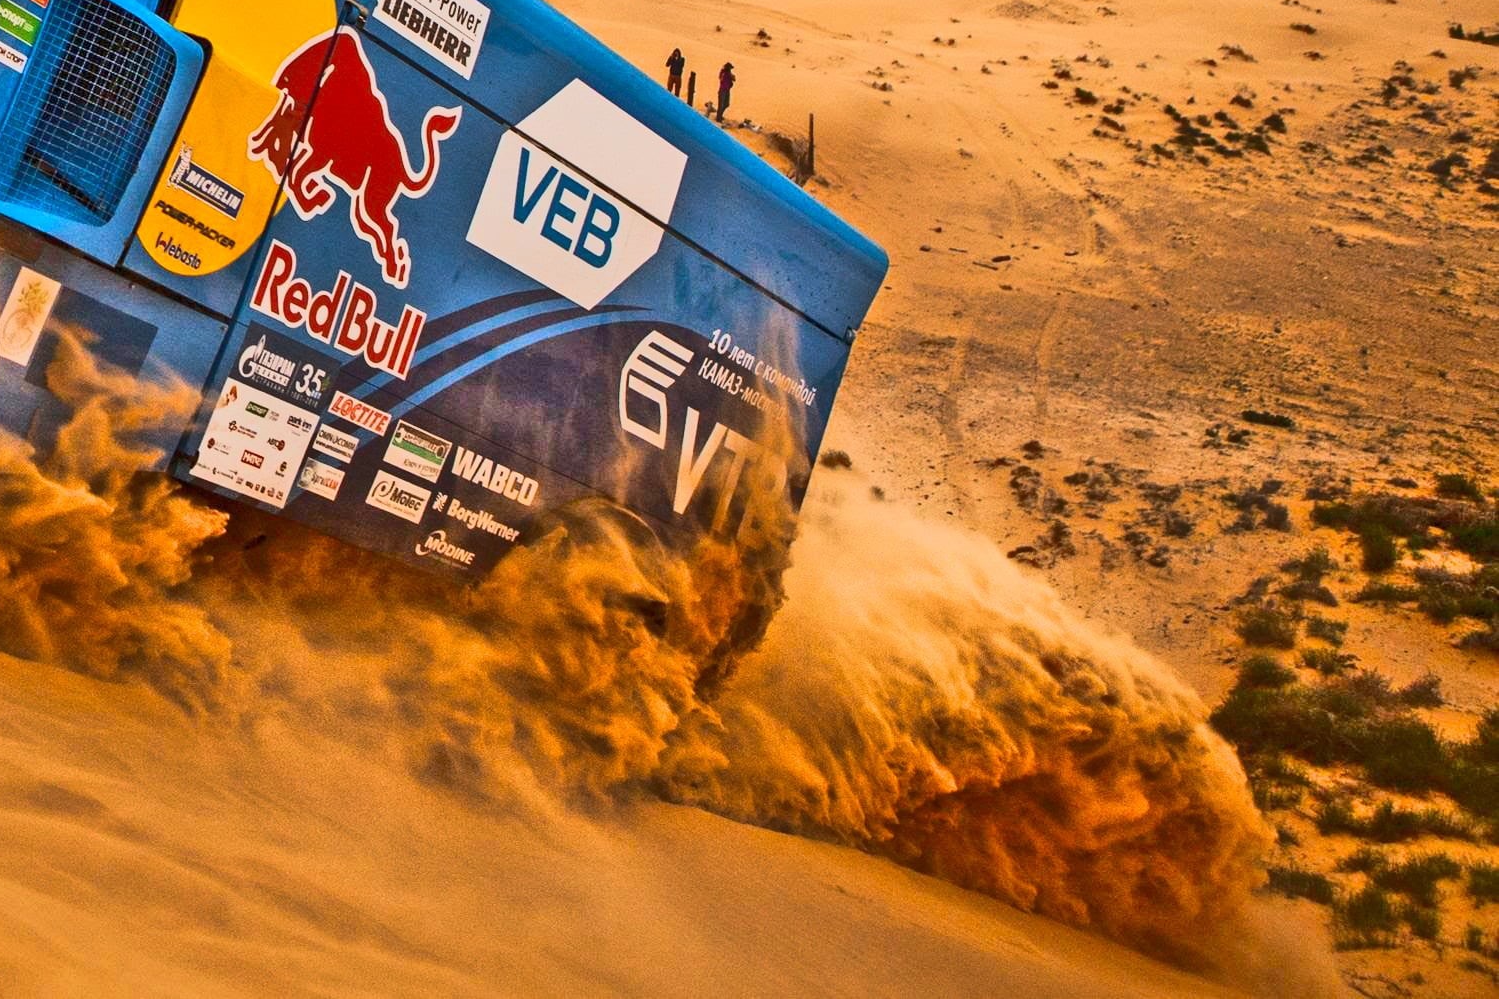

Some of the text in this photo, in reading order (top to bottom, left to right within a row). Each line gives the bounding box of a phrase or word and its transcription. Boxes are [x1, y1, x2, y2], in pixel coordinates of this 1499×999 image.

[186, 170, 242, 210] MICHELIN
[513, 147, 620, 269] VEB
[155, 231, 202, 270] Webasto
[251, 240, 426, 379] Red Bull
[295, 363, 327, 398] 35
[707, 328, 731, 355] 10
[728, 348, 755, 369] лет
[762, 365, 818, 407] командой
[331, 394, 390, 434] LOCTITE
[451, 446, 539, 507] WABCO
[446, 498, 520, 543] BorgWarner
[424, 535, 476, 565] MODINE
